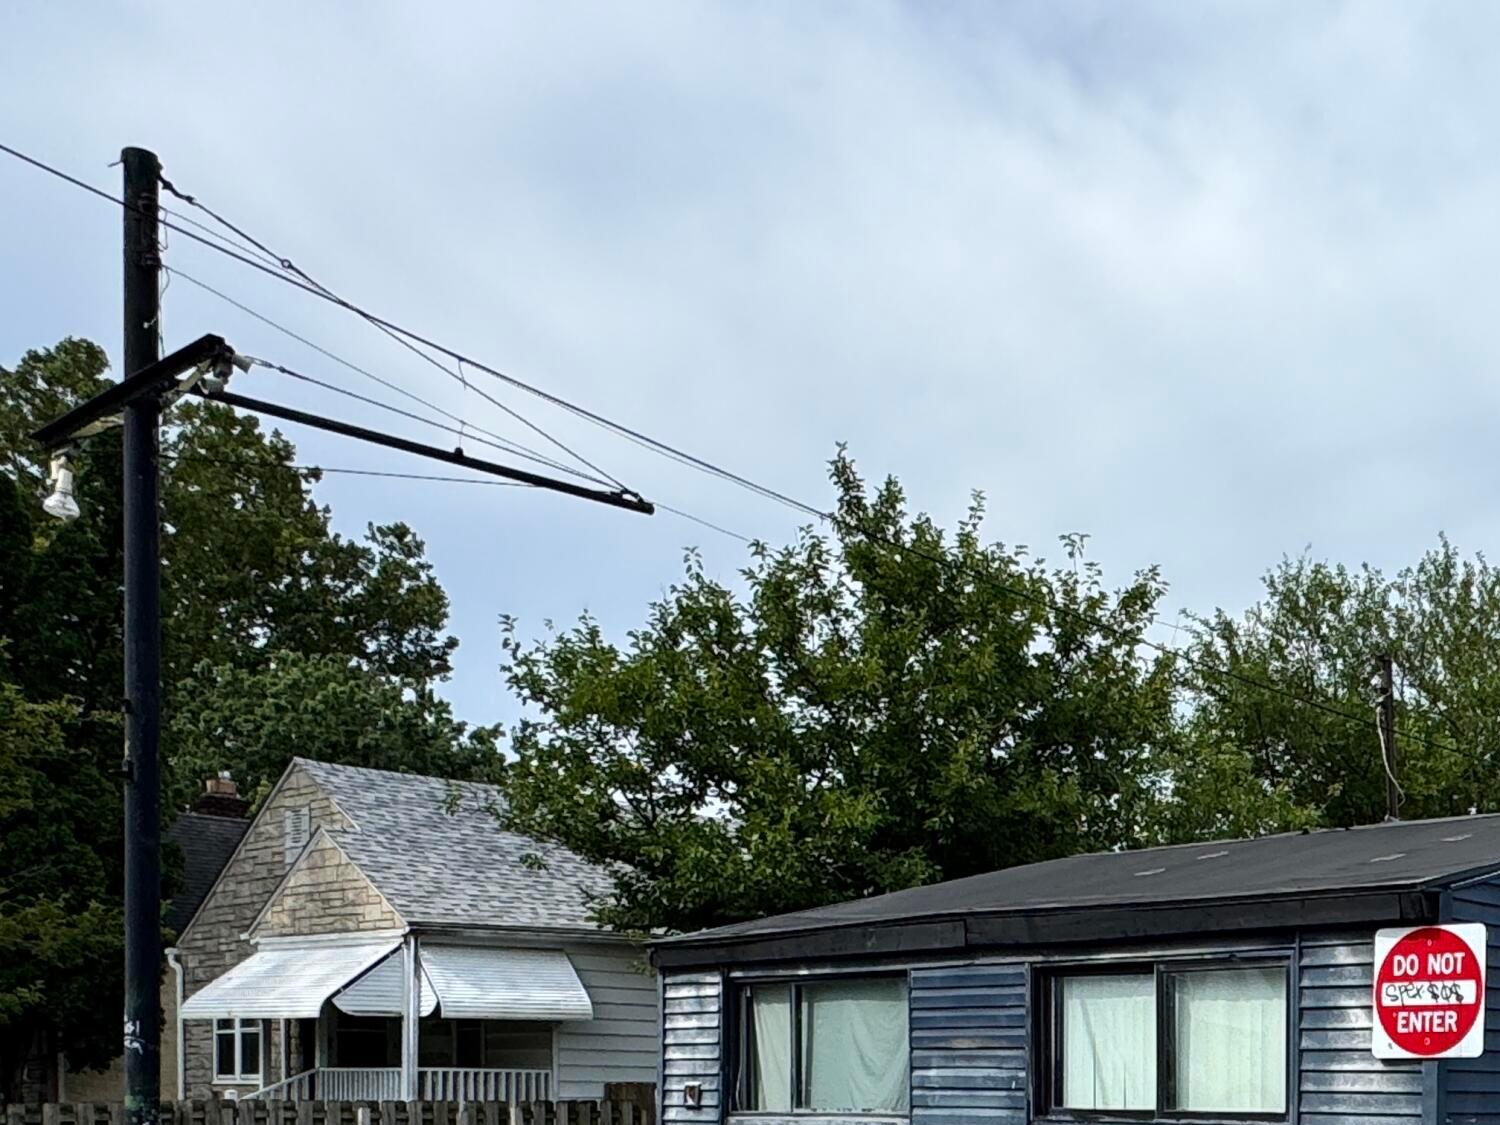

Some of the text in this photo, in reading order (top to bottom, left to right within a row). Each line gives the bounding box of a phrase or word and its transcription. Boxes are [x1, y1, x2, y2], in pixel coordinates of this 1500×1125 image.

[1393, 952, 1465, 977] DO NOT
[1397, 1010, 1458, 1034] ENTER
